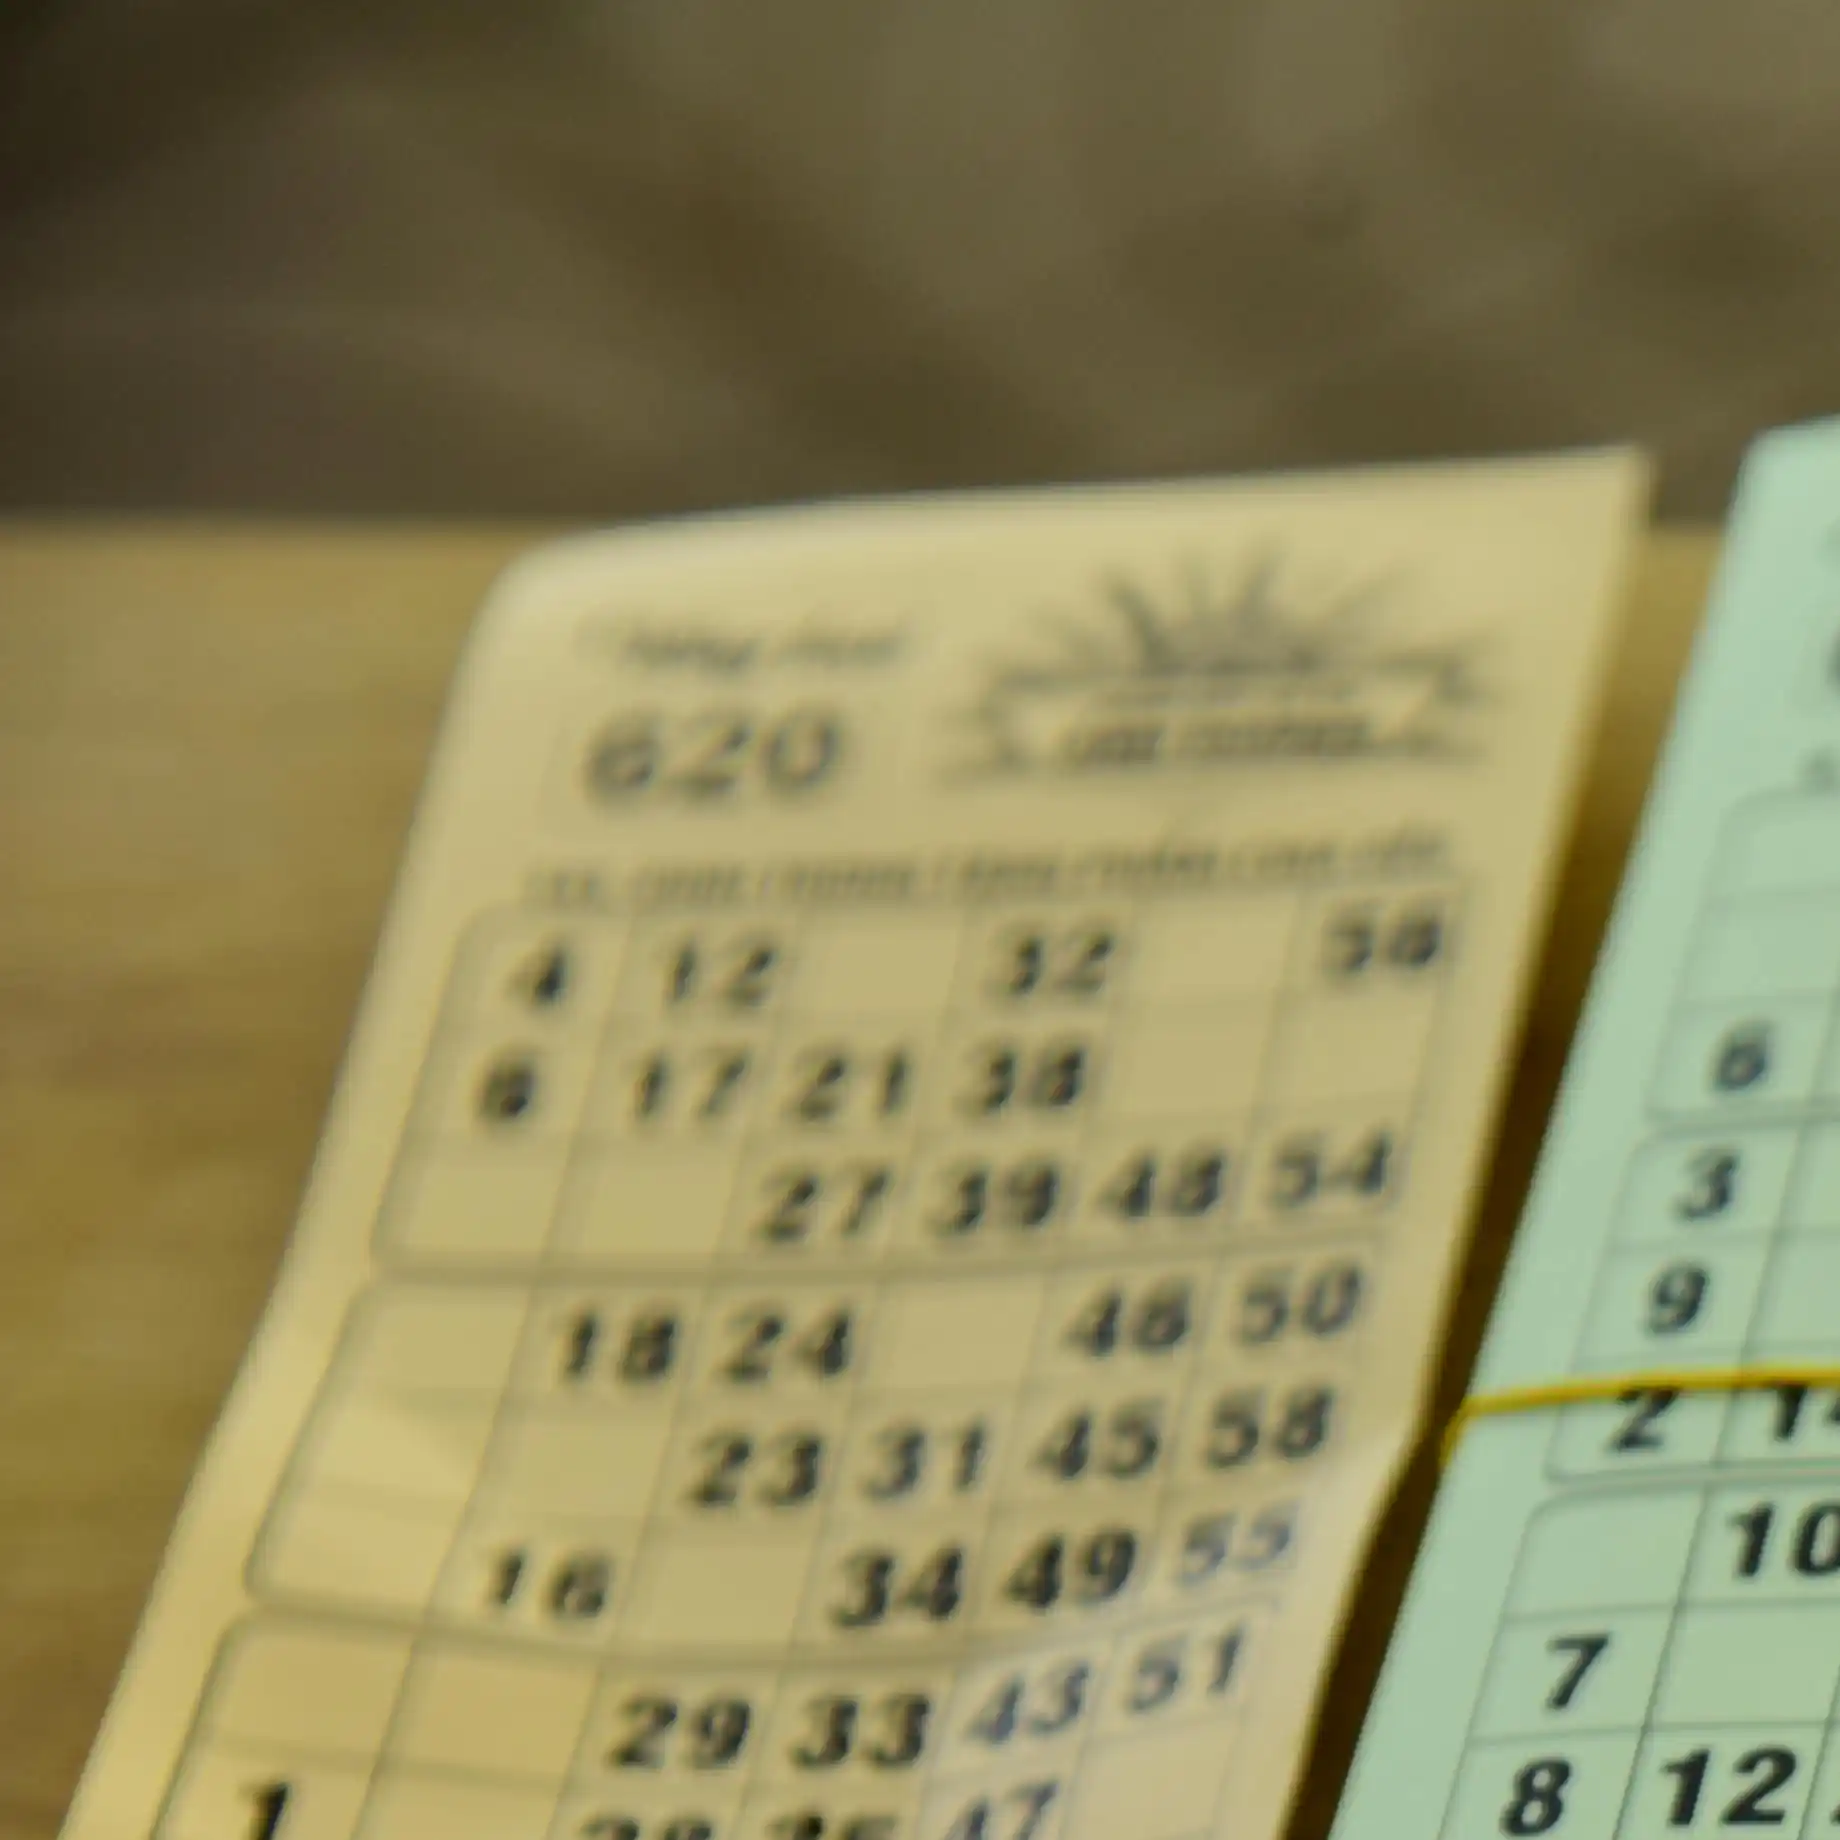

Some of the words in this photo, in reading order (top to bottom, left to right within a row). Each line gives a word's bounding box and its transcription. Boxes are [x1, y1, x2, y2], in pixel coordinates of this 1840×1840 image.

[1711, 1025, 1773, 1096] 6
[689, 1432, 825, 1510] 23
[865, 1421, 988, 1503] 31
[1036, 1404, 1164, 1483] 45
[1204, 1385, 1336, 1472] 58
[609, 1695, 753, 1771] 29
[792, 1692, 933, 1772] 33
[968, 1662, 1091, 1747] 43
[1124, 1624, 1246, 1716] 51
[1546, 1632, 1611, 1712] 7
